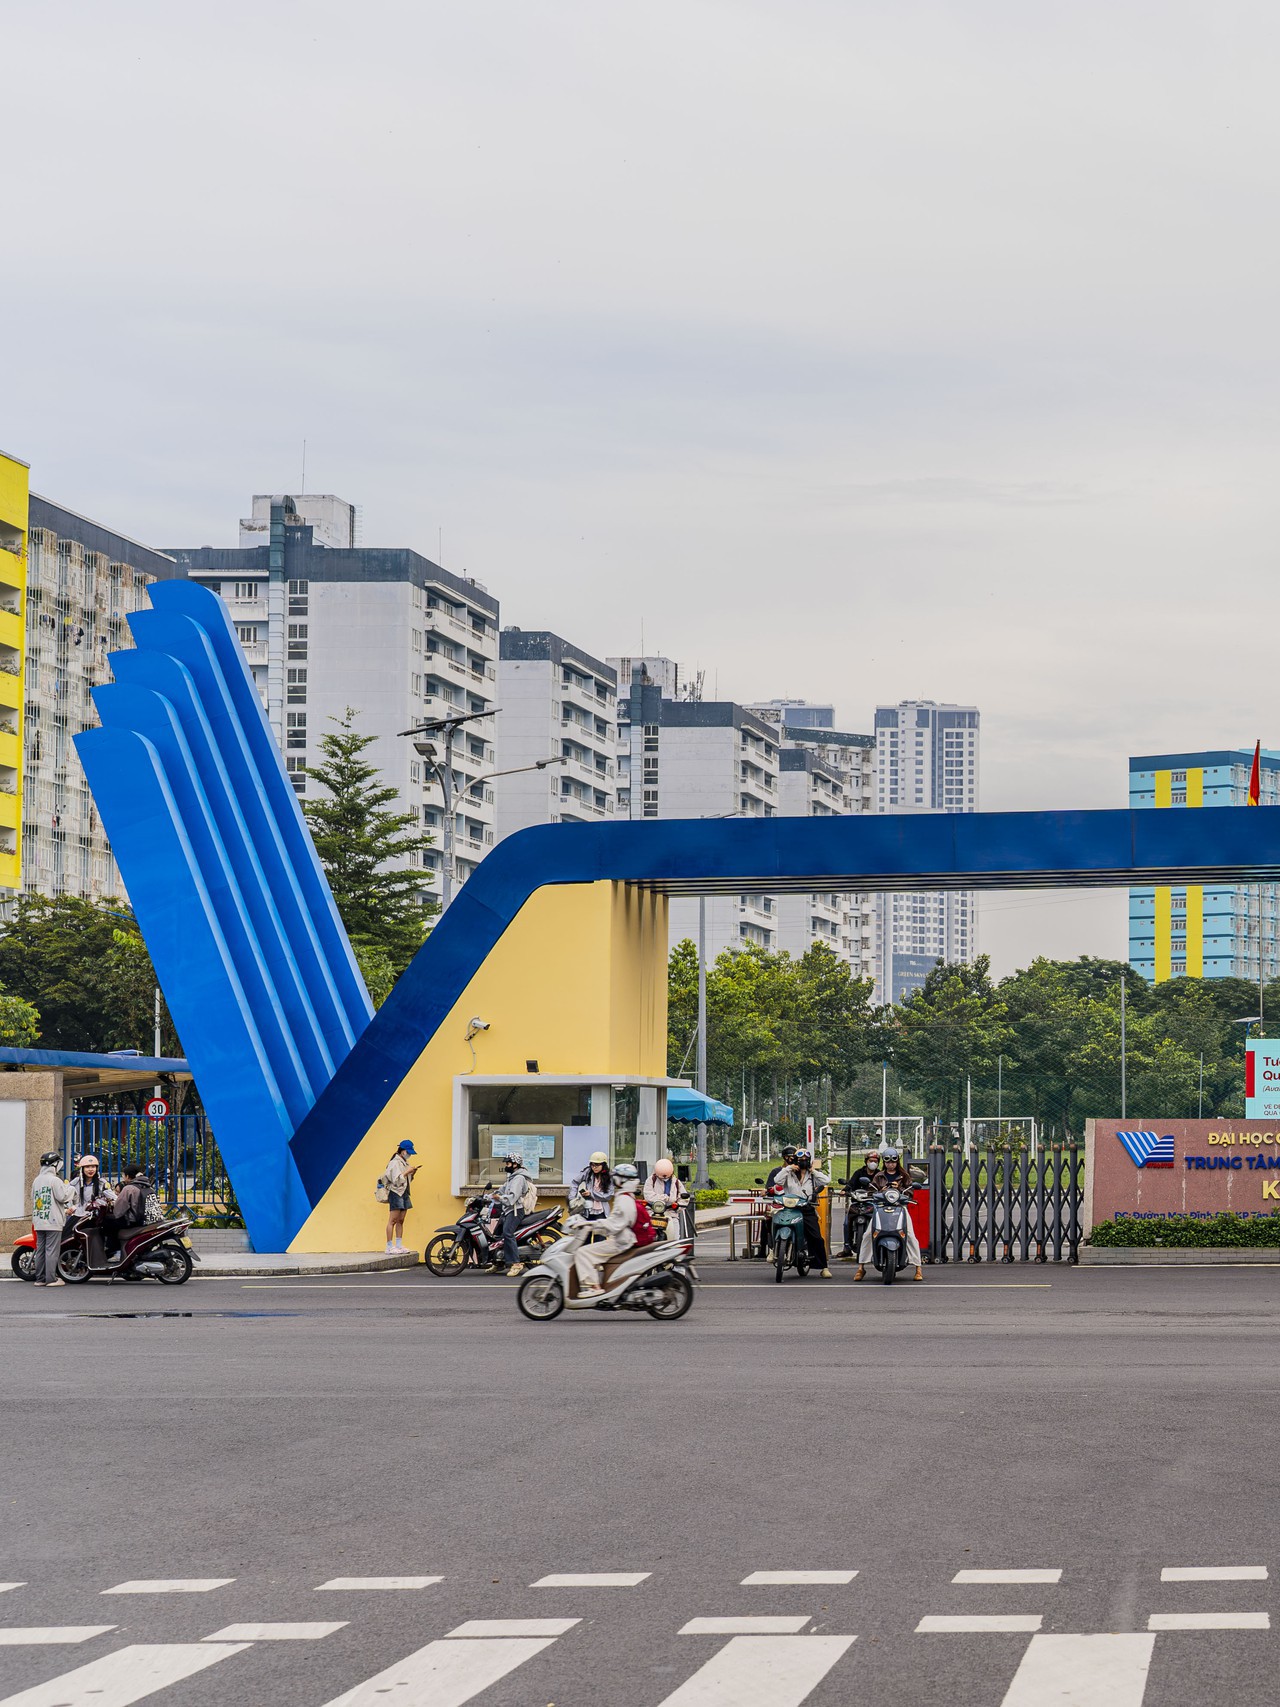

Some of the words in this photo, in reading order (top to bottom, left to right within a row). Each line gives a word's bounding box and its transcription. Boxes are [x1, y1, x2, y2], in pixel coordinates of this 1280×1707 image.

[151, 1104, 164, 1115] 30
[1207, 1132, 1236, 1148] ĐẠI
[1240, 1132, 1274, 1148] HỌC
[1184, 1156, 1242, 1170] TRUNG
